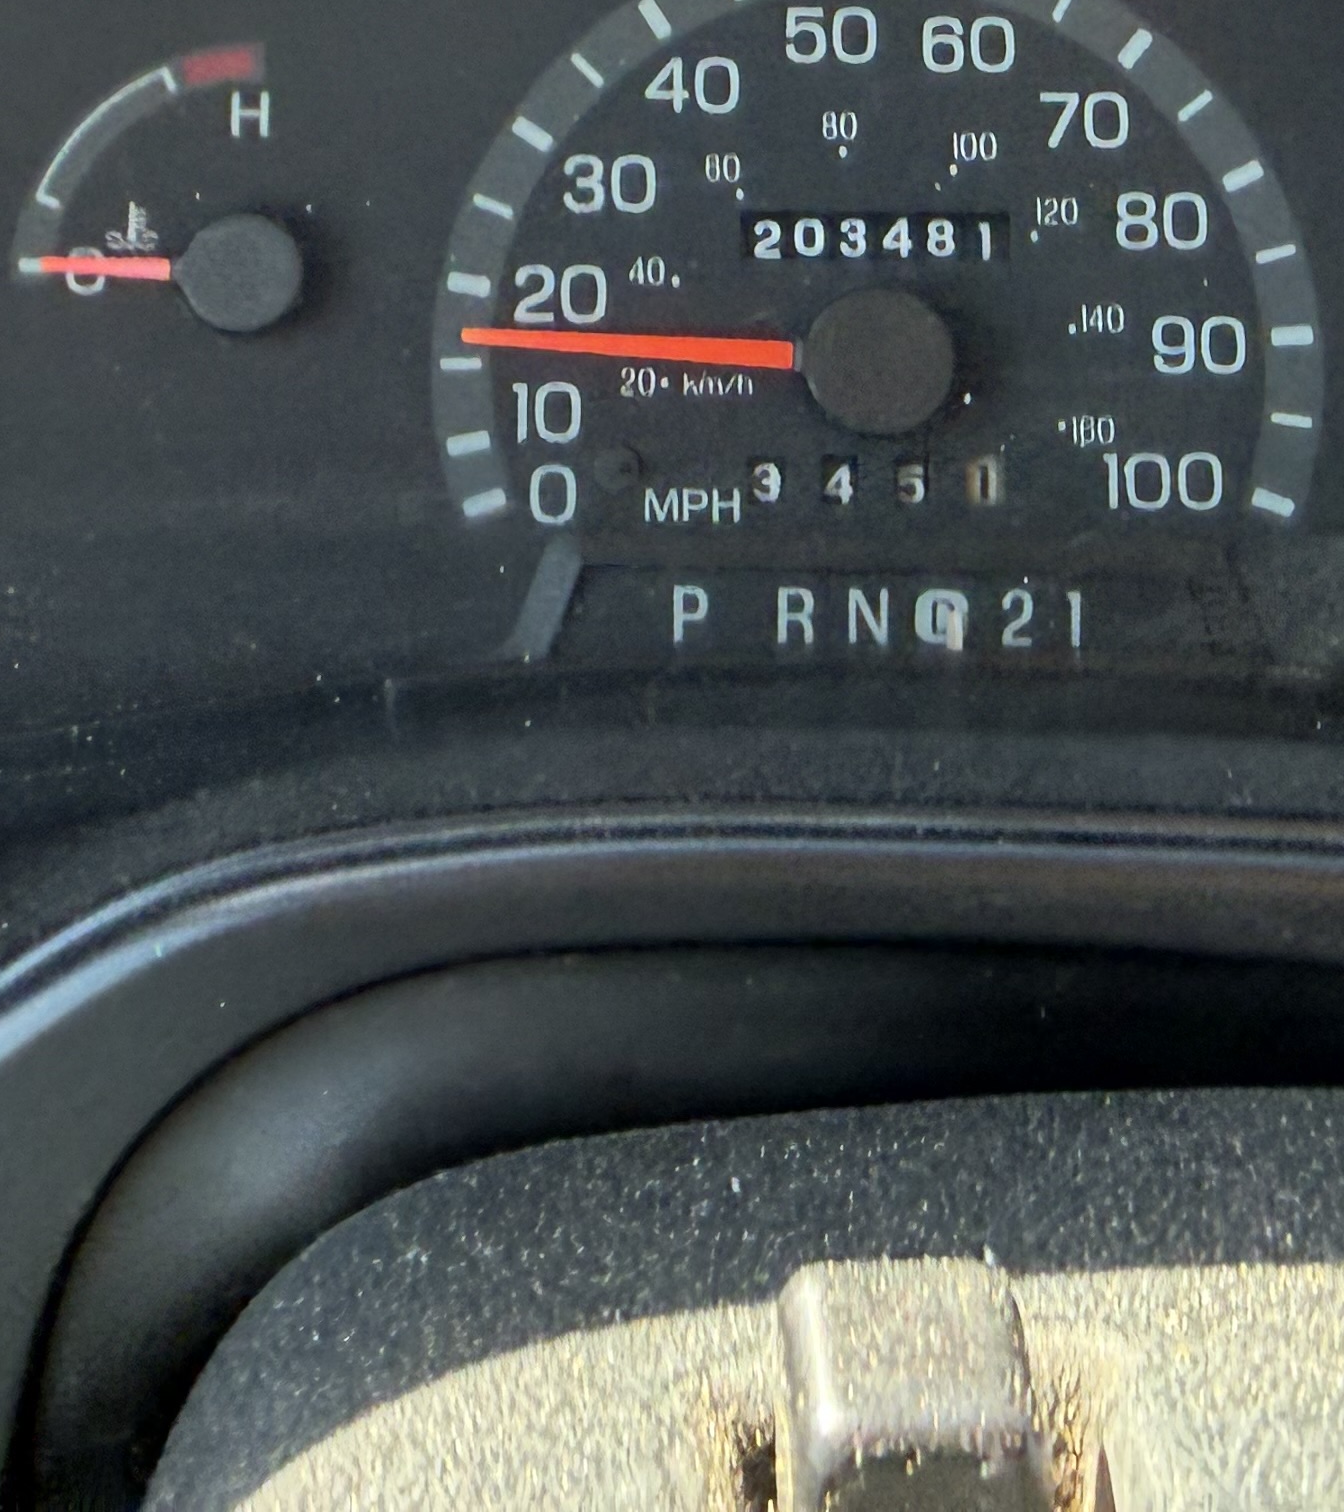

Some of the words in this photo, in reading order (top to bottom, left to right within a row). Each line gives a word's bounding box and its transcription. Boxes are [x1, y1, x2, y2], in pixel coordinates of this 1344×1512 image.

[785, 6, 877, 64] 50
[922, 15, 1015, 73] 60
[644, 56, 740, 114] 40
[230, 91, 270, 138] H
[822, 110, 857, 140] 80
[1039, 91, 1129, 149] 70
[953, 131, 997, 161] 100
[563, 153, 656, 214] 30
[1035, 196, 1079, 227] 120
[754, 217, 992, 260] 203481
[1116, 191, 1208, 250] 80
[513, 263, 607, 324] 20
[628, 256, 666, 286] 40
[1082, 303, 1125, 334] 140
[1152, 315, 1247, 375] 90
[620, 367, 656, 398] 20
[512, 381, 582, 444] 10
[529, 464, 577, 525] 0
[644, 488, 741, 523] MPH
[1103, 452, 1223, 511] 100
[673, 585, 709, 643] P
[777, 586, 814, 645] R
[848, 587, 889, 646] N
